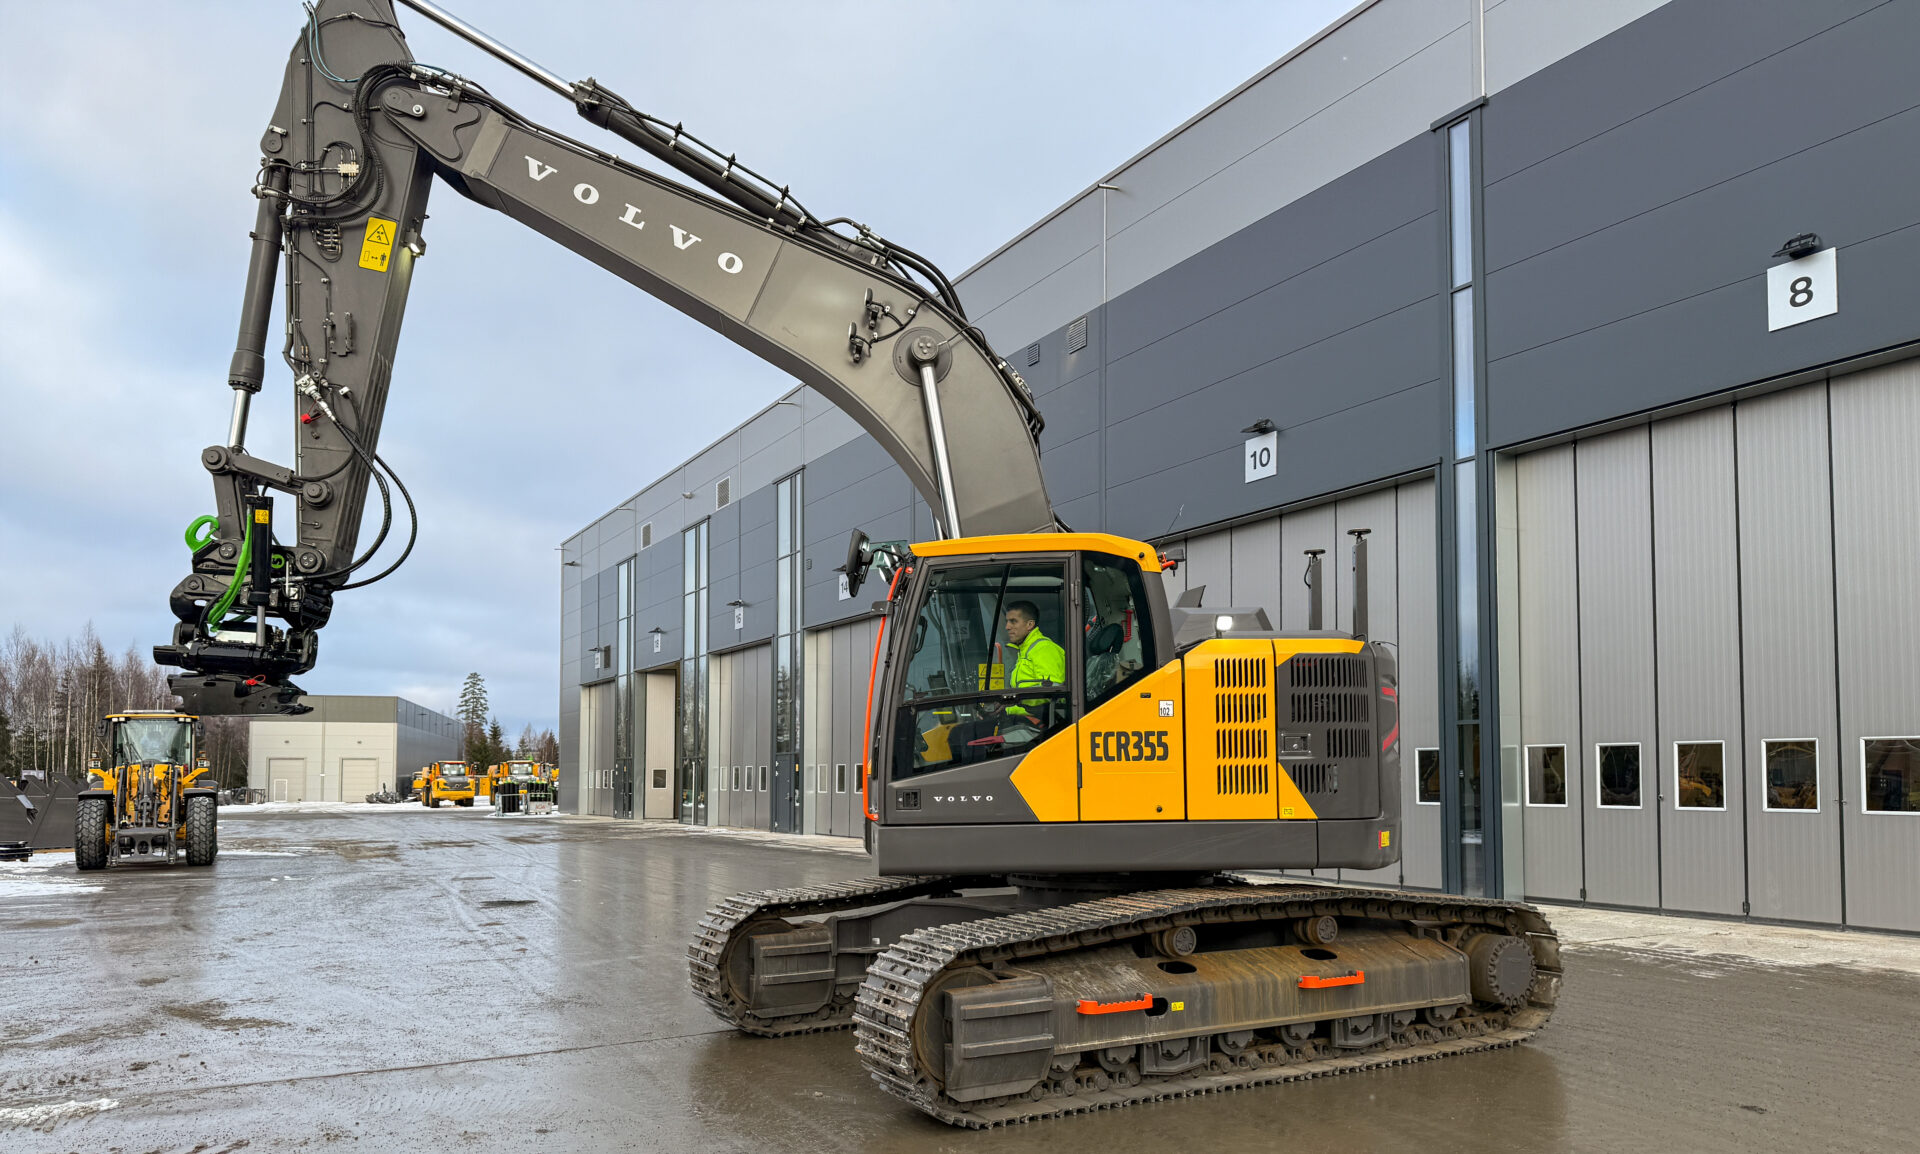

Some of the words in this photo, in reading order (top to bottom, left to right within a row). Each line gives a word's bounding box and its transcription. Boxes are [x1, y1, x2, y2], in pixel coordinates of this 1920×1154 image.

[524, 155, 744, 274] VOLVO
[1789, 276, 1814, 308] 8
[1250, 447, 1271, 470] 10
[841, 580, 848, 594] 14
[1160, 706, 1170, 716] 102
[1090, 731, 1169, 762] ECR355
